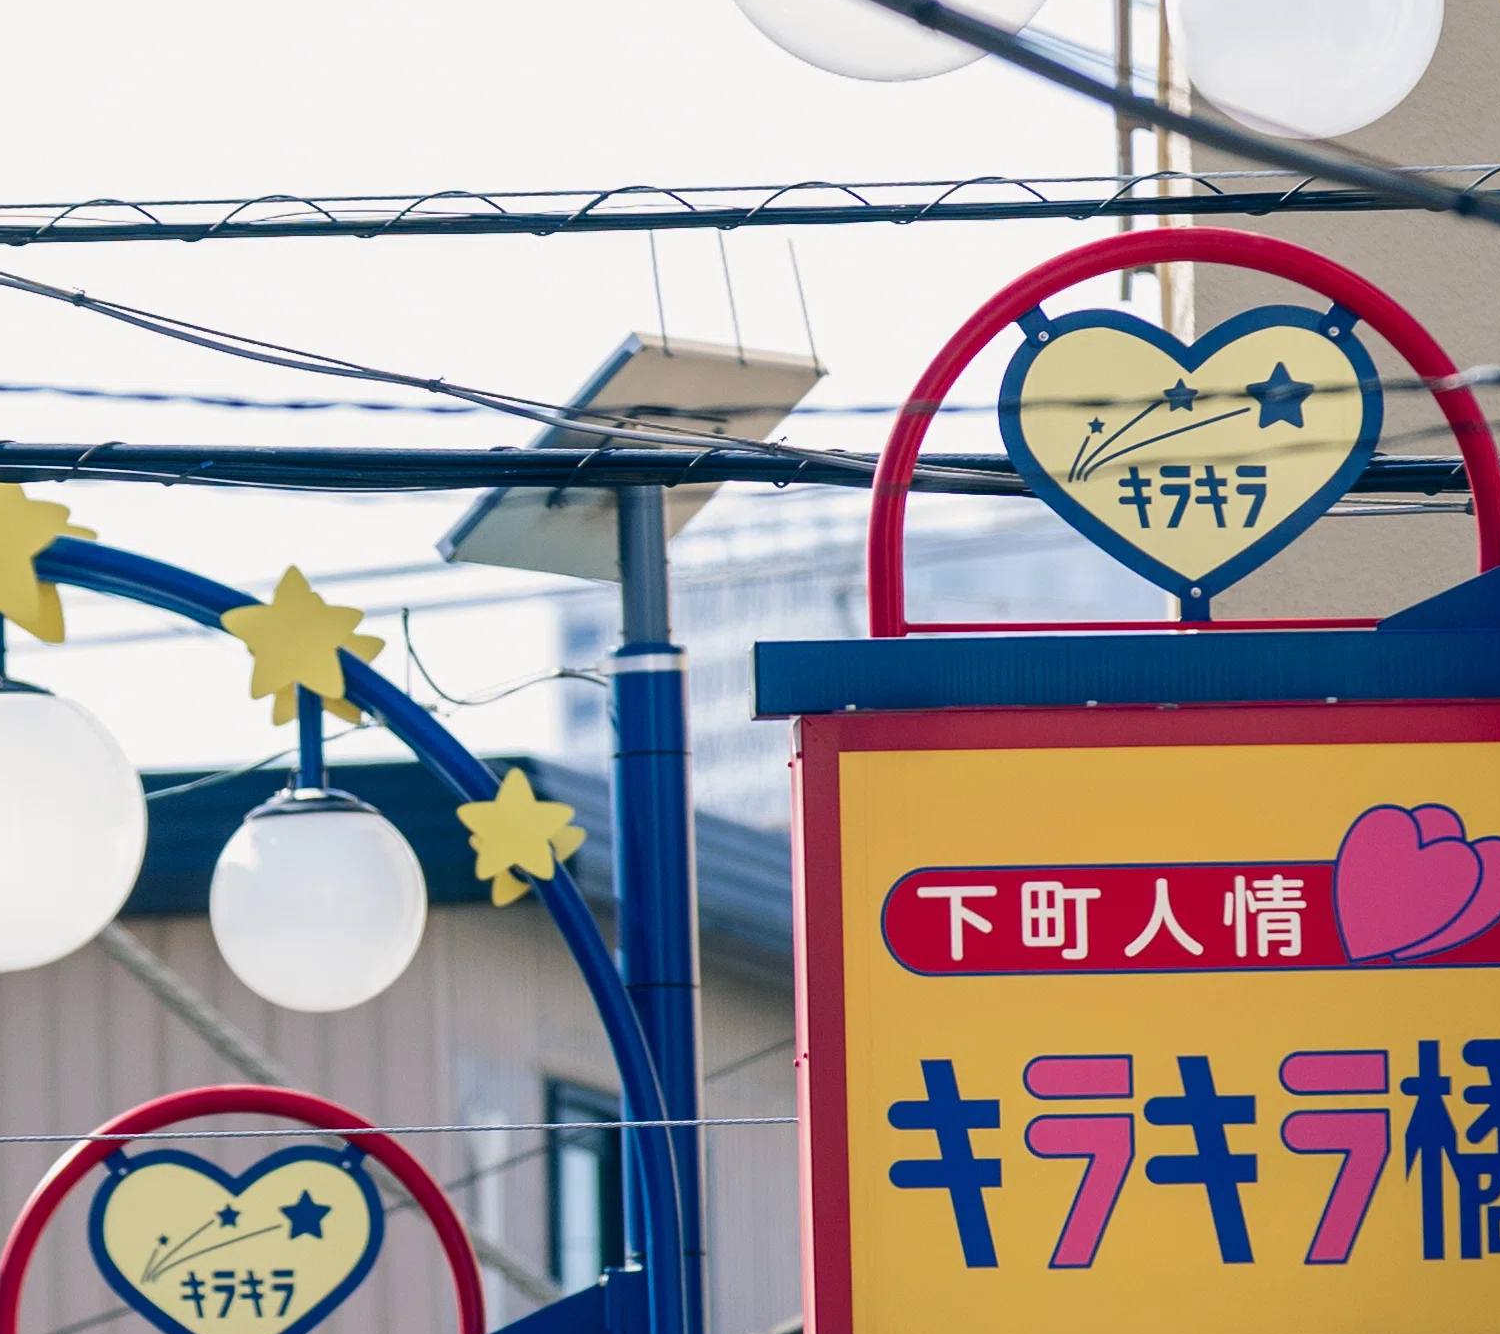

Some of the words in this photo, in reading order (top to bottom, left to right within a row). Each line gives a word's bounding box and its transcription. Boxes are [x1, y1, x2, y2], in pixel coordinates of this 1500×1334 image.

[1117, 463, 1271, 530] キラキラ
[915, 872, 1309, 964] 下町人情
[179, 1268, 298, 1322] キラキラ
